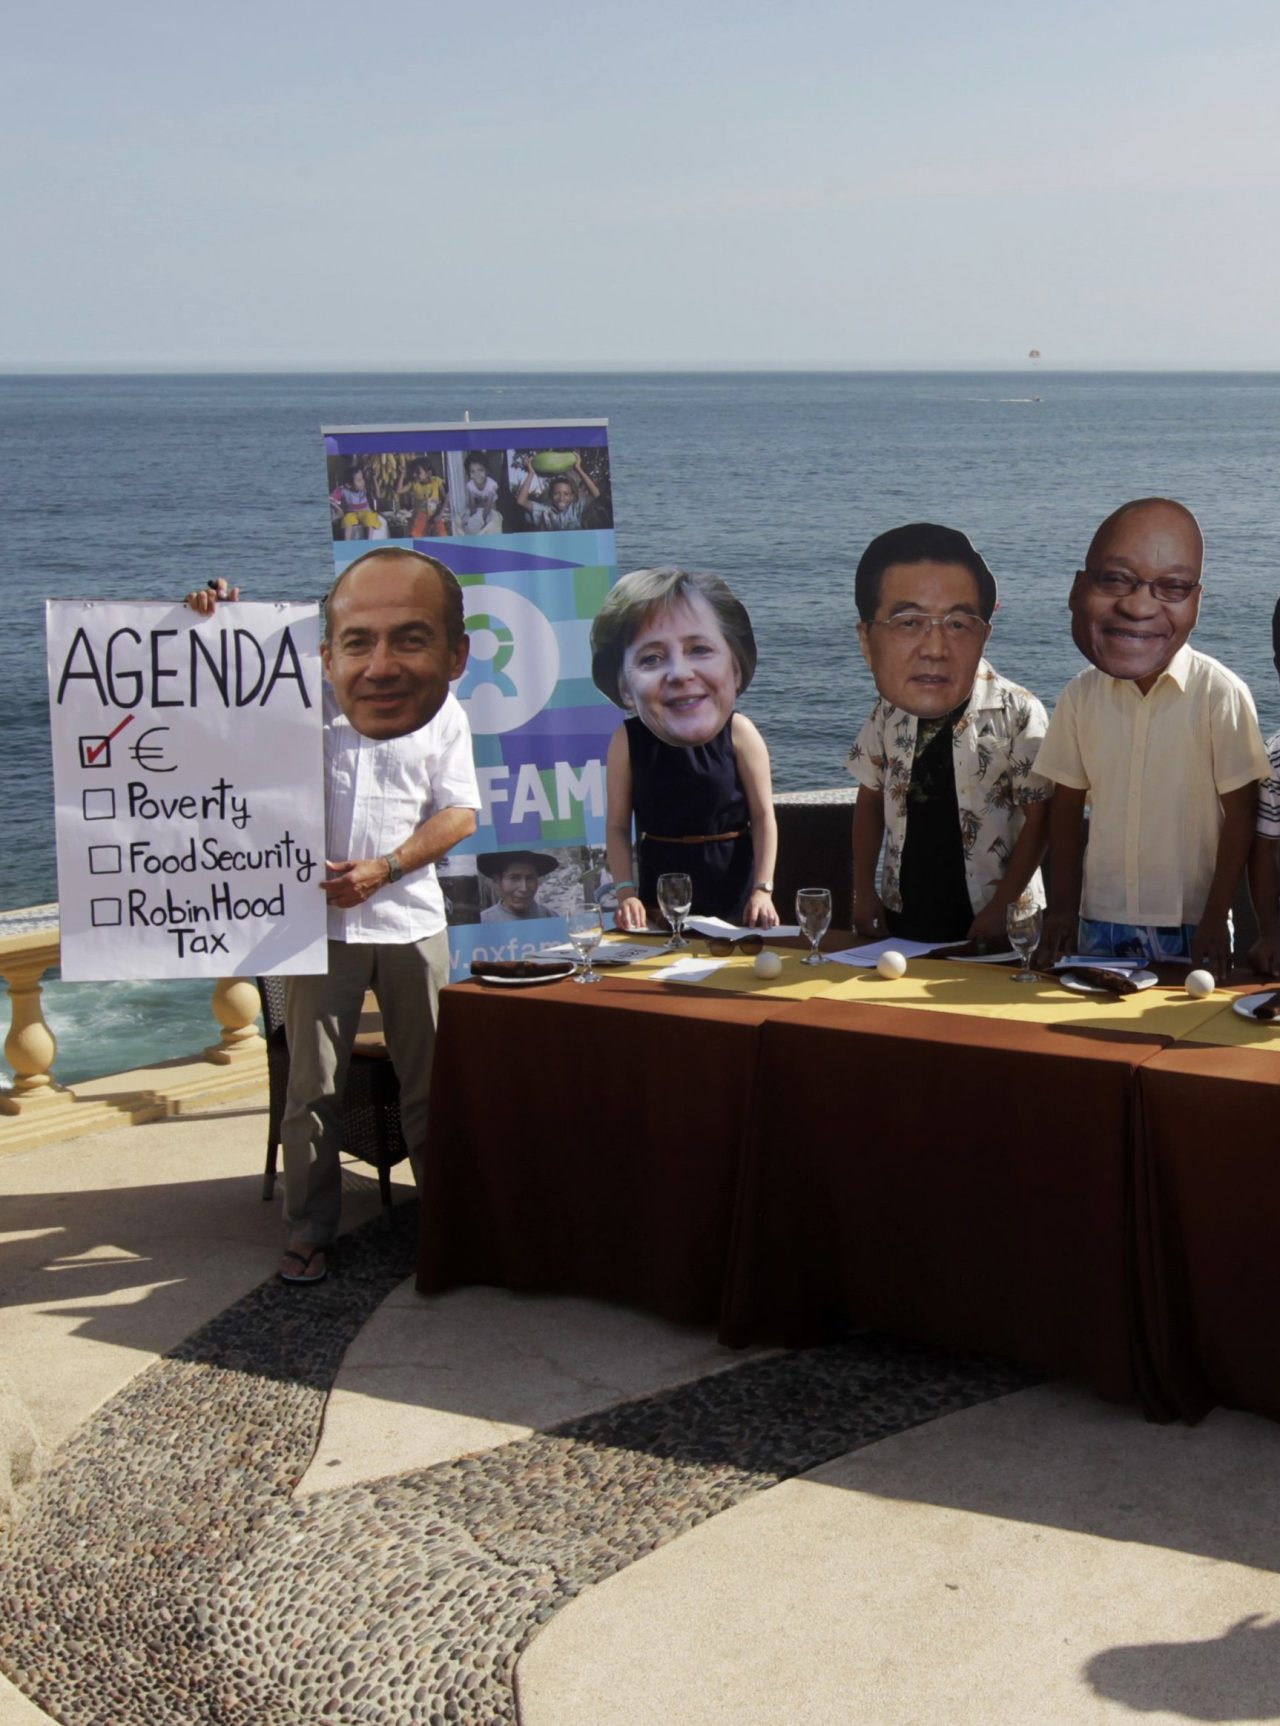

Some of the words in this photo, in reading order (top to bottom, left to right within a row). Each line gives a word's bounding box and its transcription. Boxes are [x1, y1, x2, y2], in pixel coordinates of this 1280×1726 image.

[57, 627, 312, 709] AGENDA
[127, 777, 252, 829] Poverty
[476, 759, 605, 826] FAM
[167, 928, 229, 958] Tax
